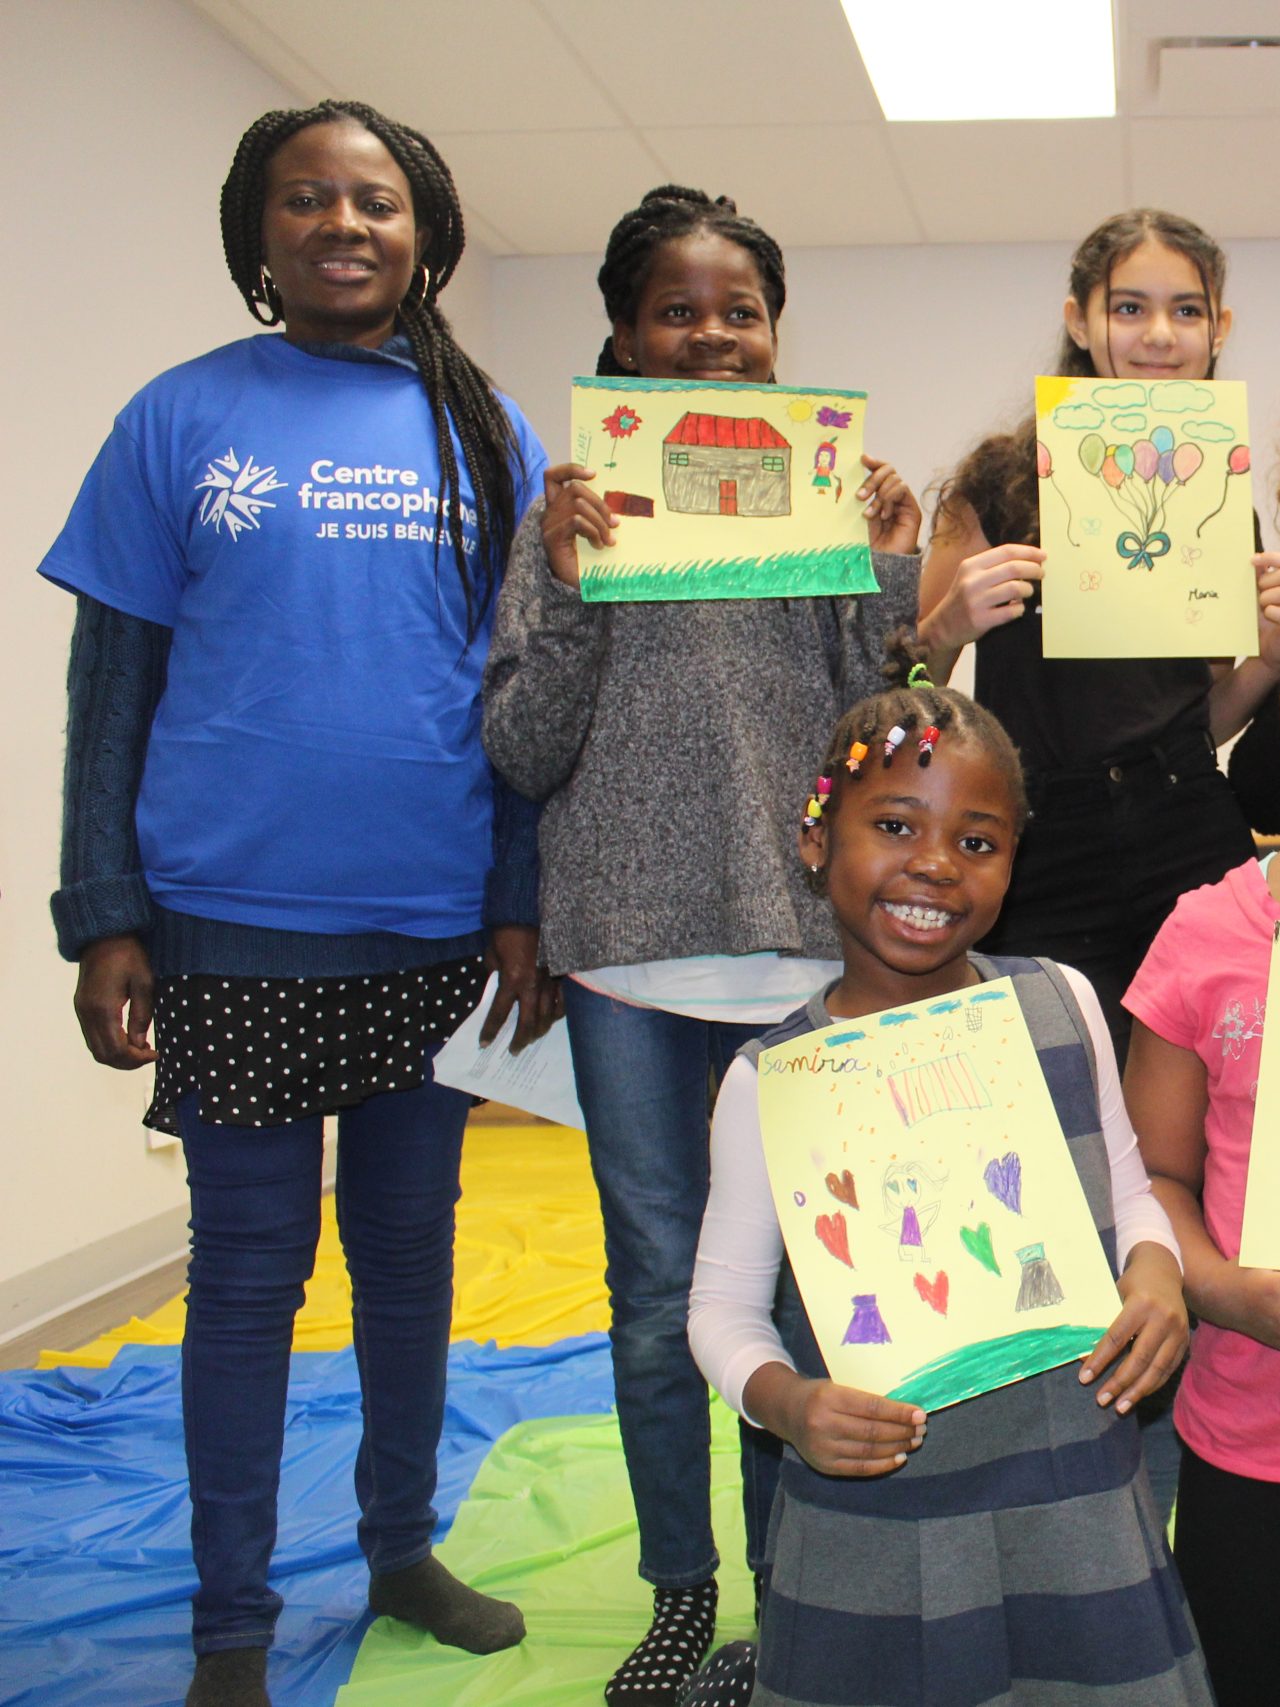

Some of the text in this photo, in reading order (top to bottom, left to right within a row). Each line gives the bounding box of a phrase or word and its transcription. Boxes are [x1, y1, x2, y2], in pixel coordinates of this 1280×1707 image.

[310, 459, 420, 487] Centre
[316, 520, 476, 555] JE SUIS BÉNVLE
[763, 1047, 868, 1076] Samira
